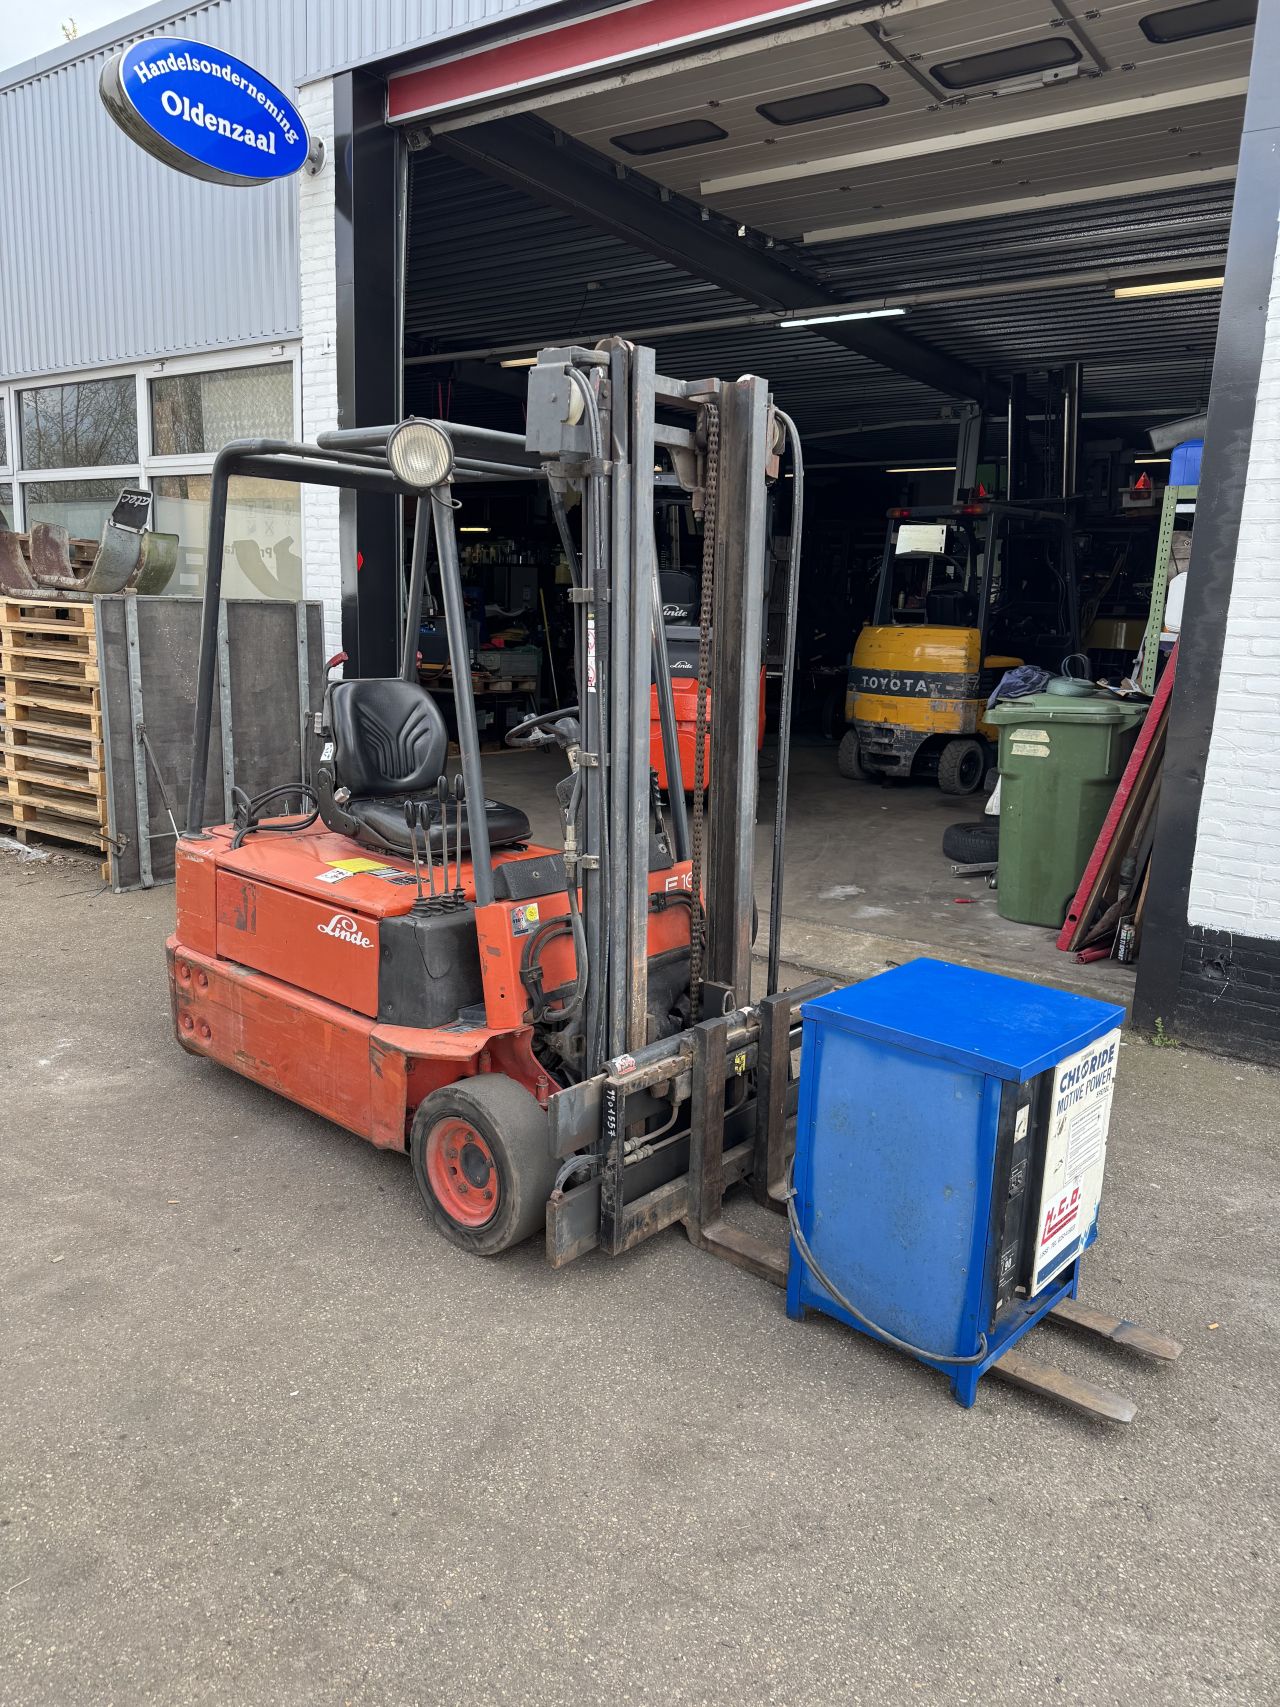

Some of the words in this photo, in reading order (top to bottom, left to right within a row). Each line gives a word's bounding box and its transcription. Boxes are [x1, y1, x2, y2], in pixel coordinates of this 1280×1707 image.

[133, 53, 299, 145] Handelsonderneming
[161, 90, 276, 155] Oldenzaal
[669, 660, 693, 669] Linde
[862, 675, 928, 692] TOYOTA
[317, 914, 374, 948] Linde
[1056, 1083, 1084, 1116] MOTIVE
[1085, 1067, 1112, 1096] POWER
[1059, 1042, 1116, 1094] CHLORIDE
